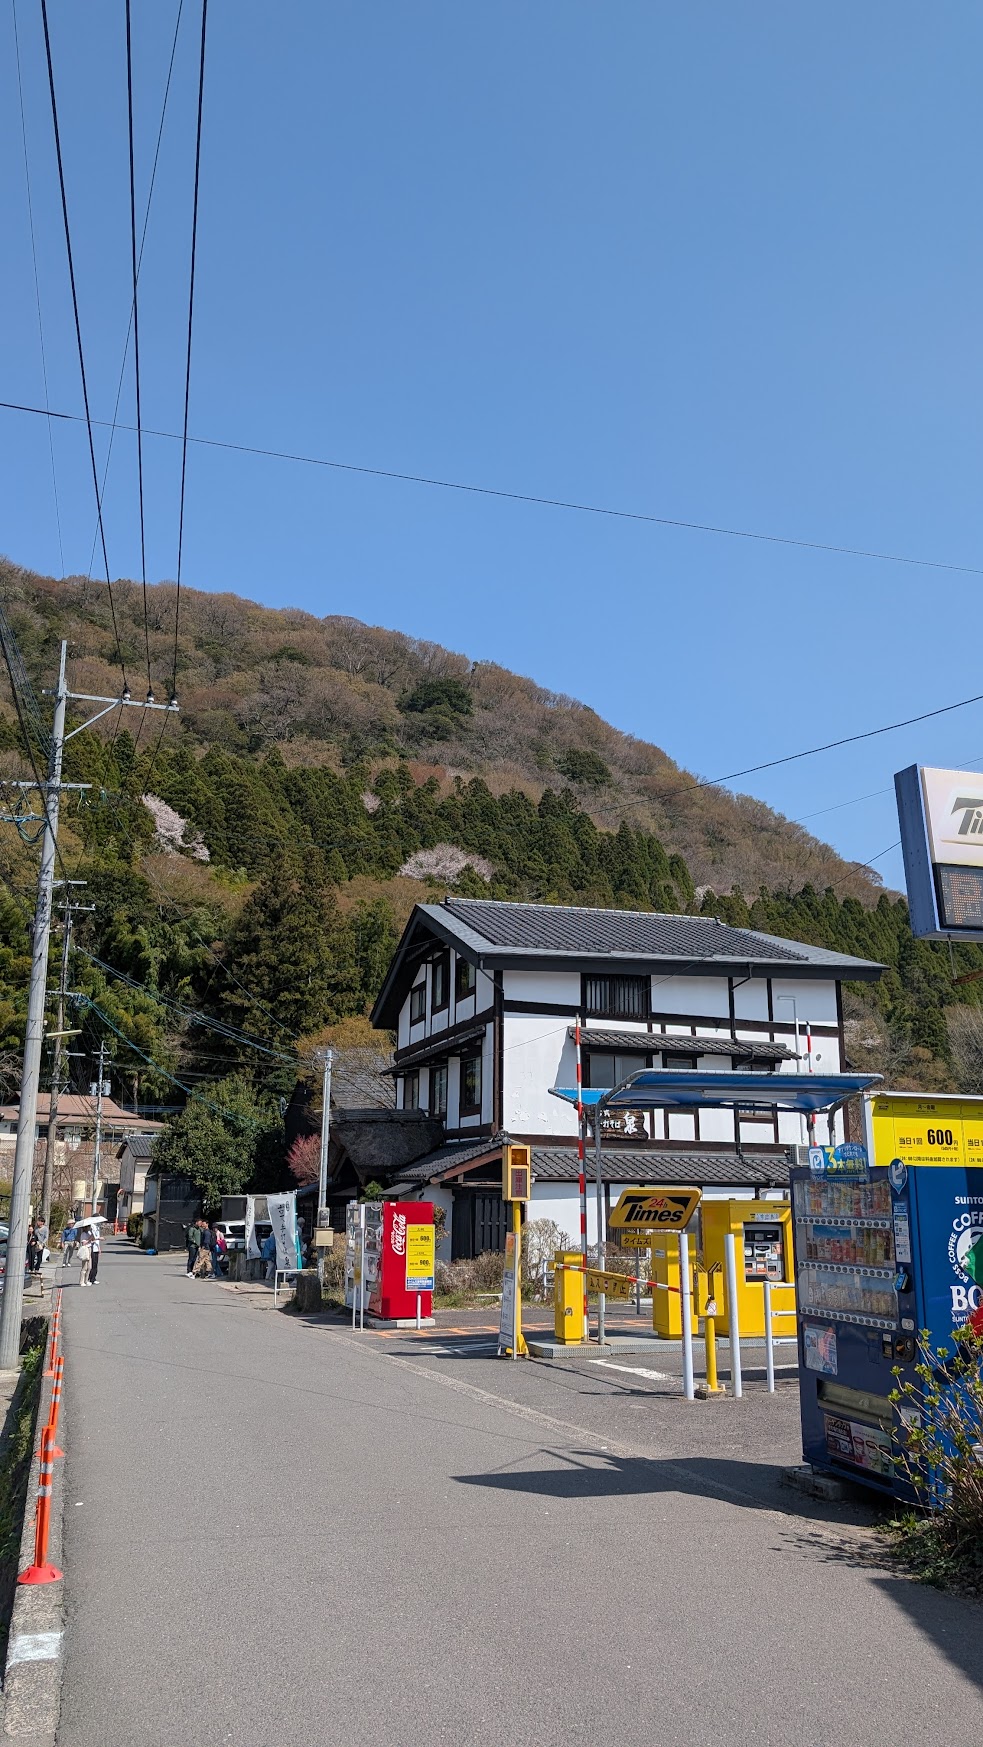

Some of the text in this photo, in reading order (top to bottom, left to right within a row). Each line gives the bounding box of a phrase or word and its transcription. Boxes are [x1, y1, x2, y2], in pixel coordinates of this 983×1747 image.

[950, 797, 983, 835] Ti
[600, 1119, 621, 1129] 打そば
[623, 1111, 638, 1135] 泉
[621, 1197, 690, 1222] Times
[391, 1211, 407, 1256] Coca-Cola
[624, 1237, 651, 1245] タイムズ
[947, 1232, 969, 1284] BOSS COFFEE
